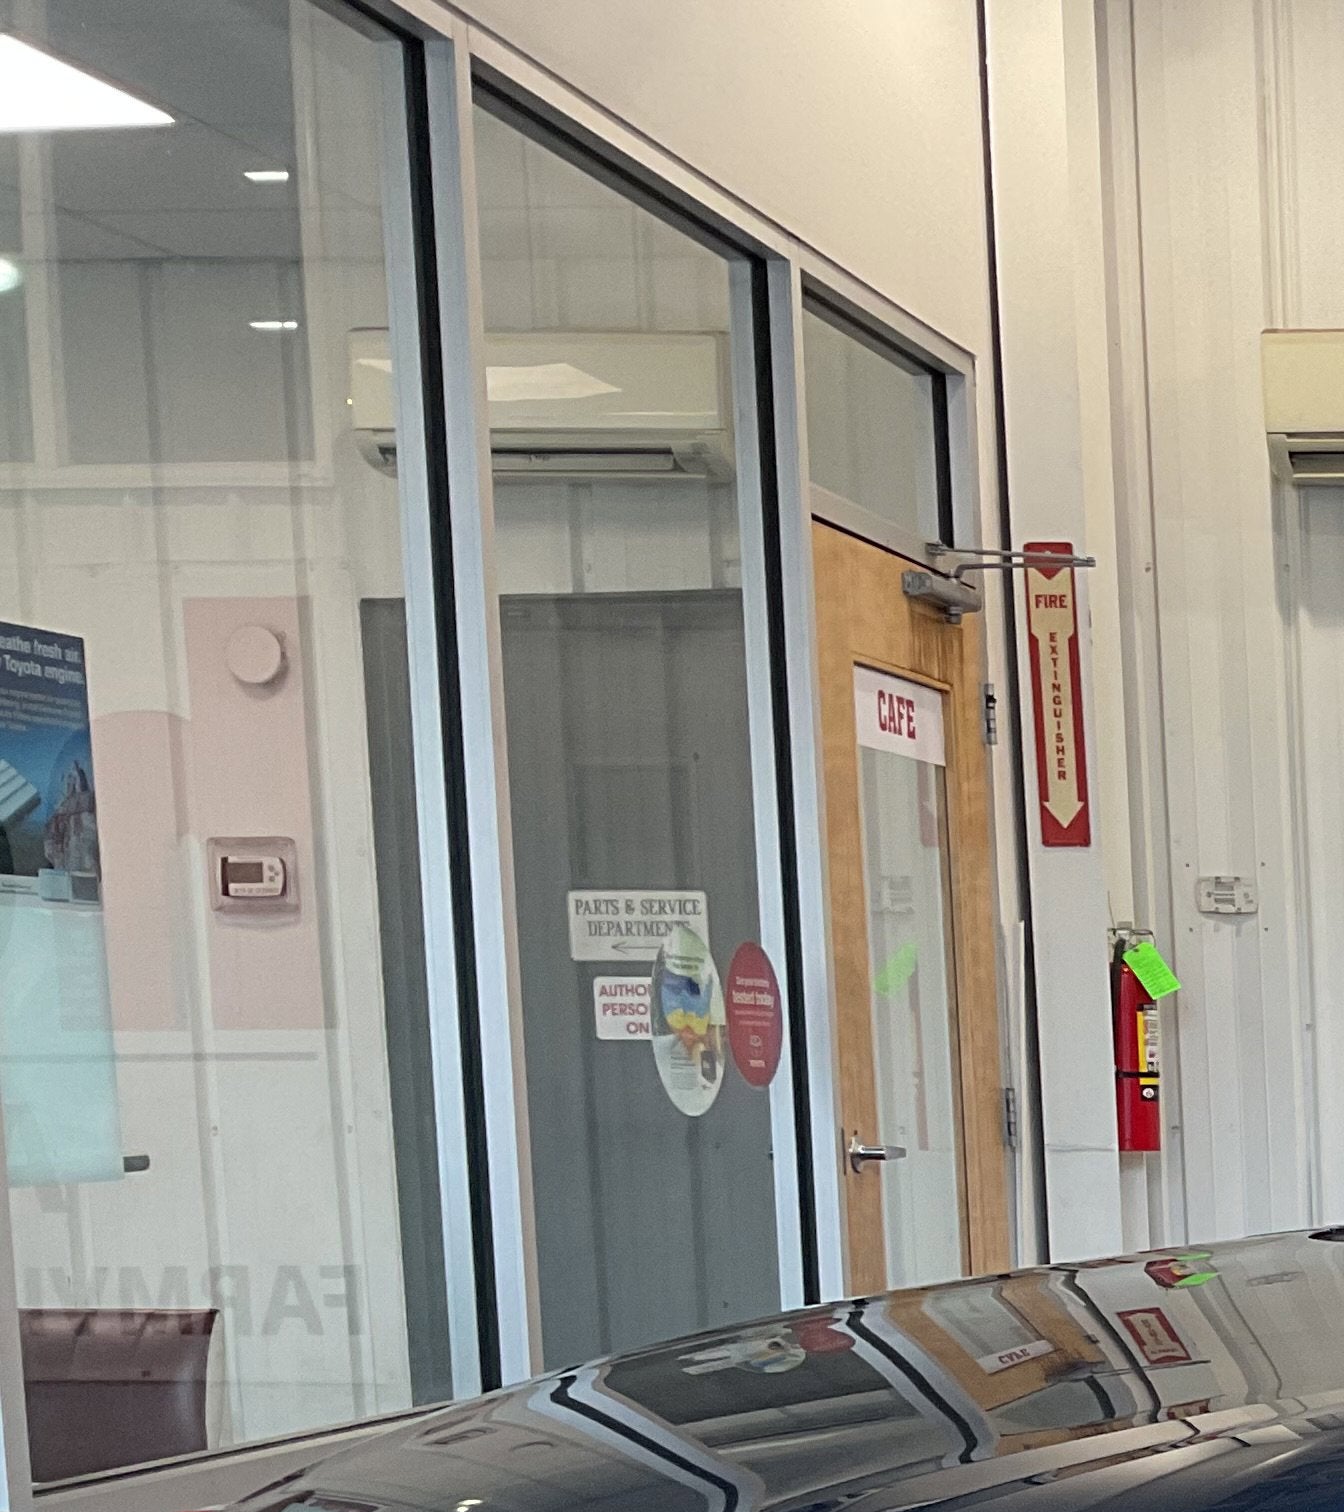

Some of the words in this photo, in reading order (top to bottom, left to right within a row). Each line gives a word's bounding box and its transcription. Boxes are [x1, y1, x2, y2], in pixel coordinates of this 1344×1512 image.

[1035, 594, 1068, 609] FIRE
[33, 639, 62, 660] fresh
[3, 654, 42, 677] Toyota
[877, 689, 917, 740] CAFE
[1049, 632, 1067, 781] EXTINGUISHER
[574, 898, 620, 916] PARTS
[625, 899, 635, 914] &
[640, 898, 702, 916] SERVICE
[588, 920, 691, 937] DEPARTMEN
[599, 984, 652, 998] AUTHO
